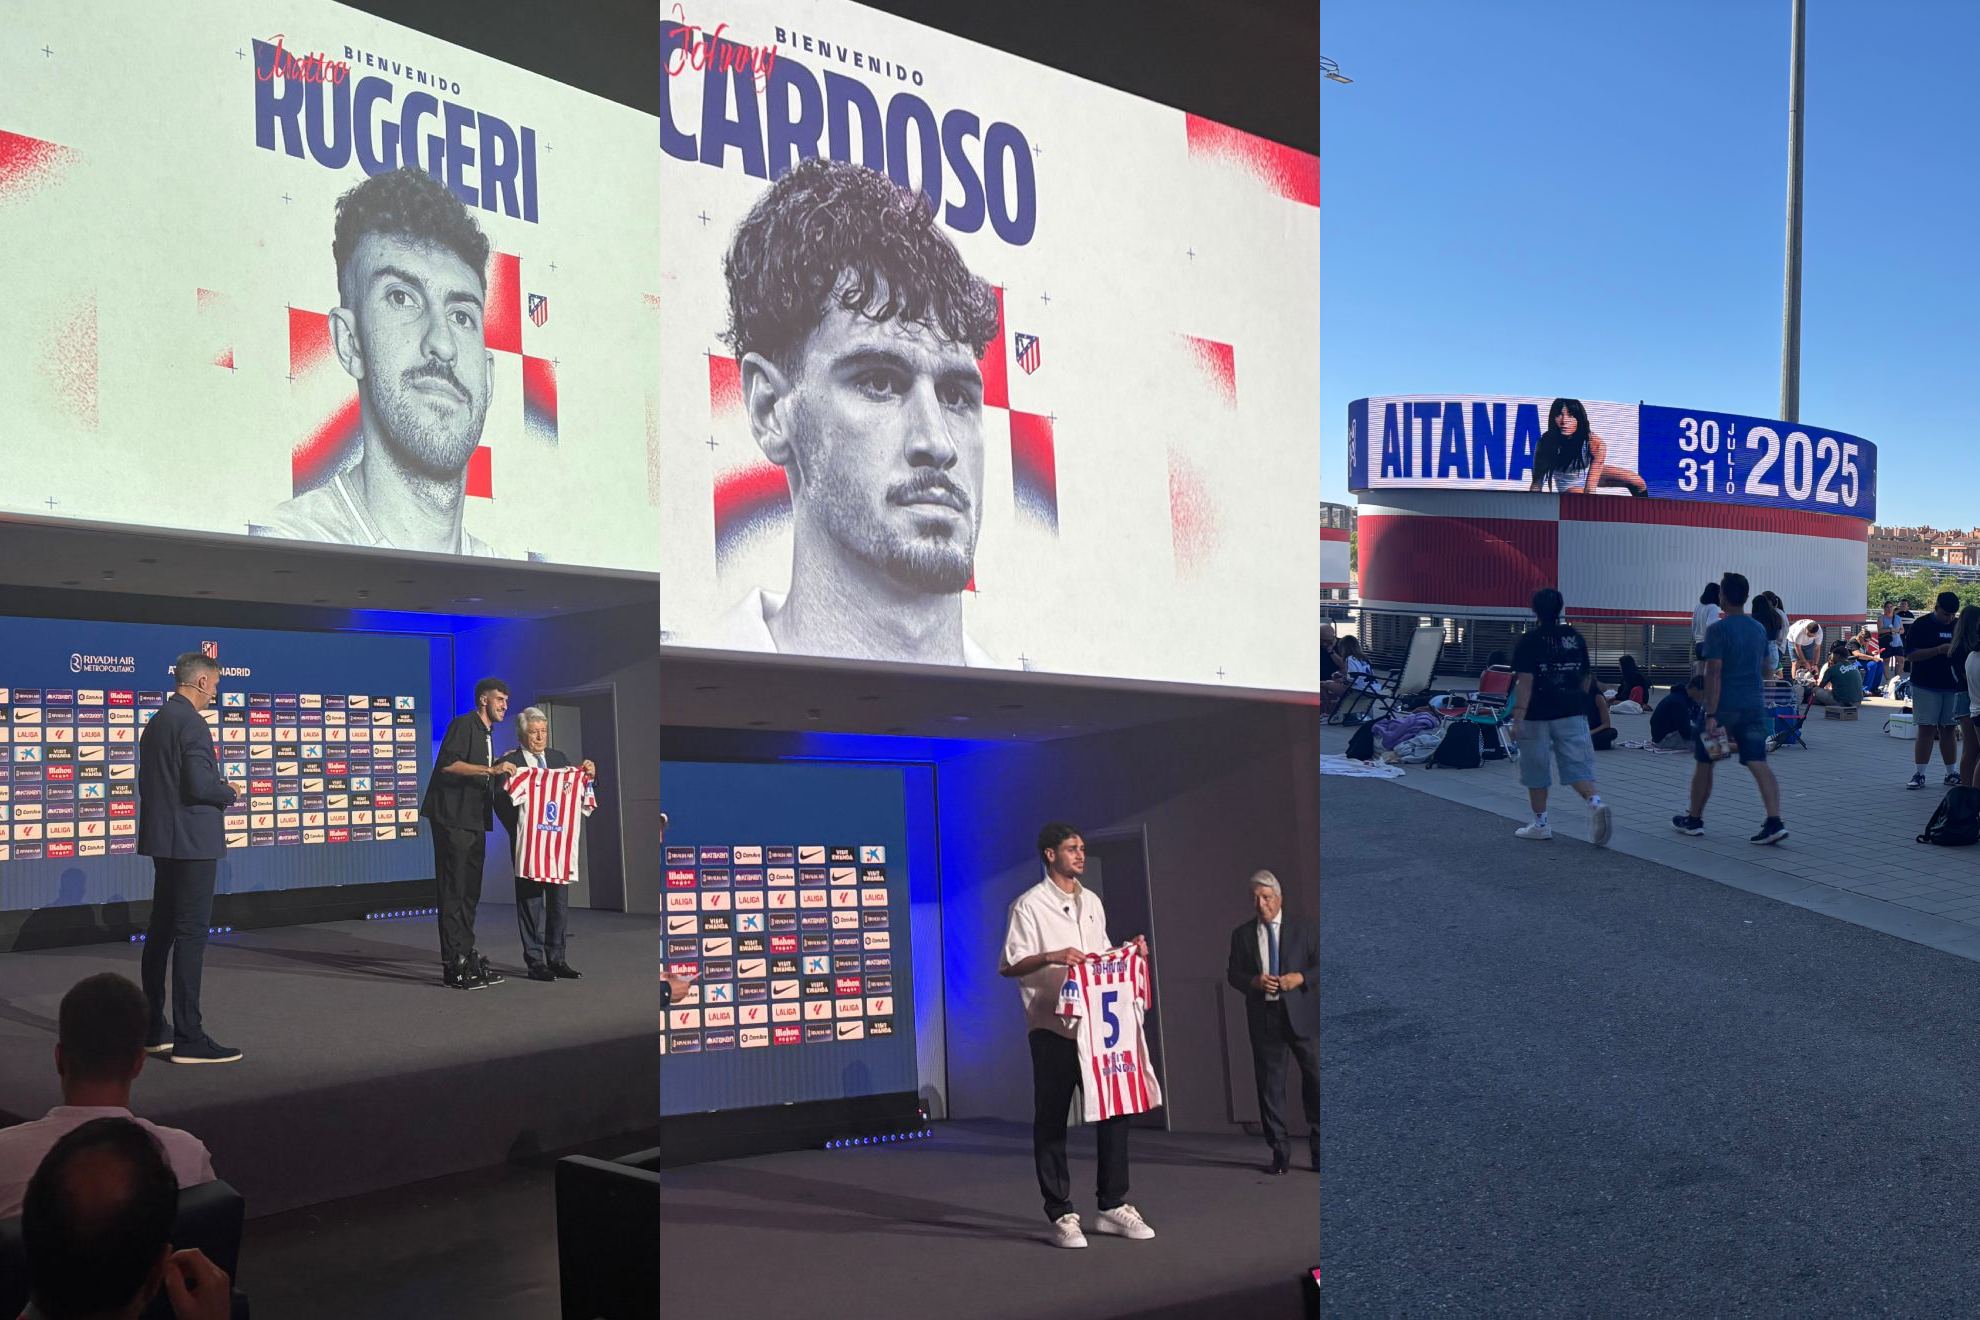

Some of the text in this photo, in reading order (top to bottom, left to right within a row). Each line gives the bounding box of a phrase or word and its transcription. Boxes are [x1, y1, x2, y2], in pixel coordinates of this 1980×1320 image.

[344, 45, 461, 95] BIENVENIDO
[775, 26, 924, 86] BIENVENIDO
[252, 38, 539, 224] RUGGERI
[660, 20, 1036, 246] CARDOSO
[1381, 402, 1542, 480] AITANA
[1678, 417, 1720, 454] 30
[1678, 458, 1715, 493] 31
[1726, 423, 1736, 494] JULIO
[1745, 426, 1859, 507] 2025
[83, 655, 135, 665] RIYADH AIR
[83, 665, 135, 673] METROPOLITANO
[668, 872, 694, 880] Mahou
[771, 937, 796, 946] Mahou
[670, 965, 697, 974] Mahou
[836, 979, 860, 987] Mahou
[708, 1012, 731, 1020] LALIGA
[776, 1008, 797, 1016] LALIGA
[1102, 990, 1120, 1048] 5
[775, 1029, 800, 1037] Mahou
